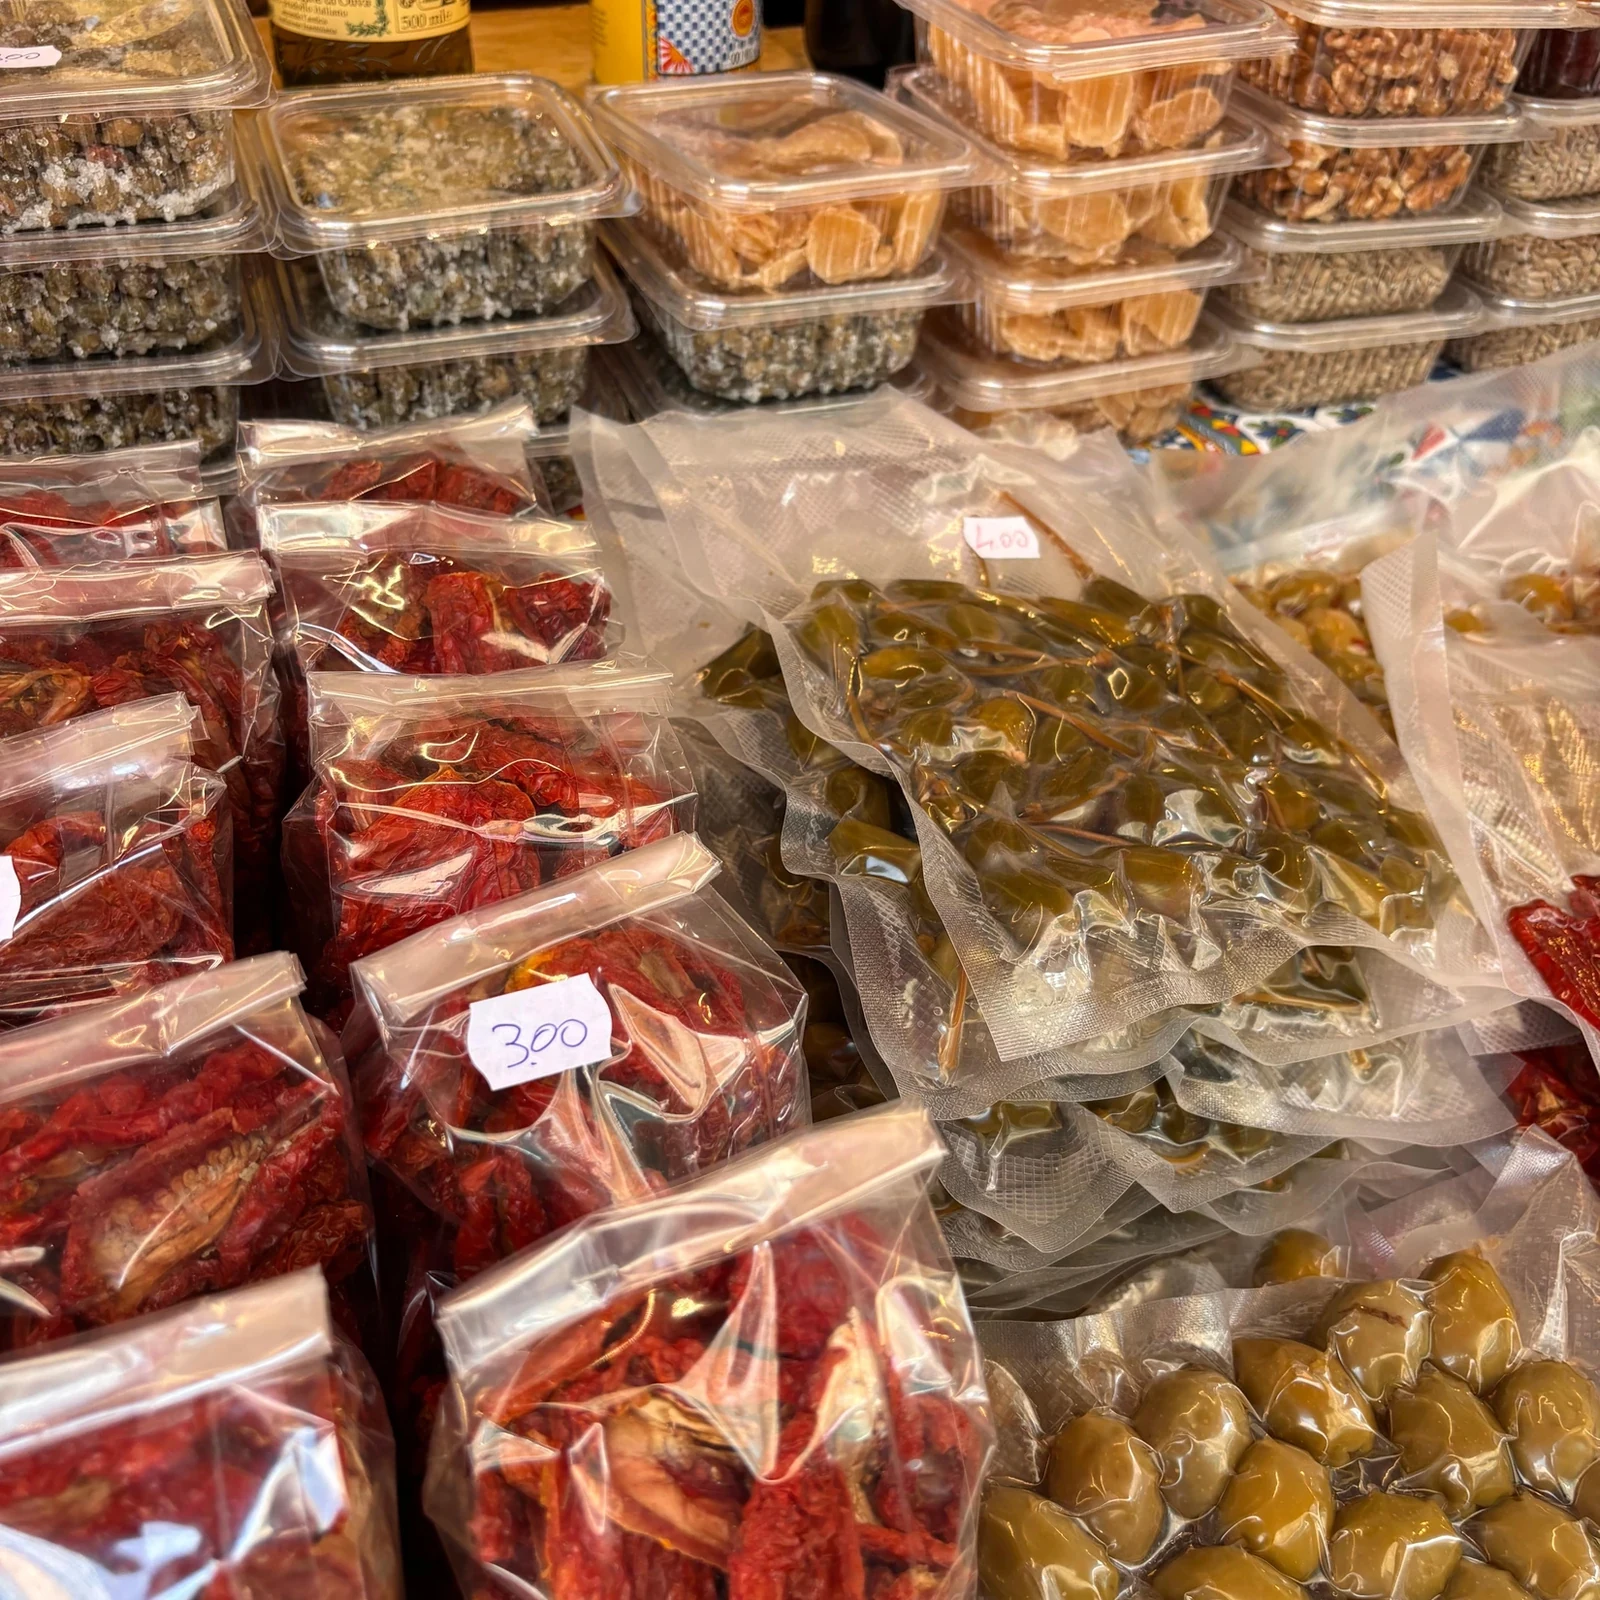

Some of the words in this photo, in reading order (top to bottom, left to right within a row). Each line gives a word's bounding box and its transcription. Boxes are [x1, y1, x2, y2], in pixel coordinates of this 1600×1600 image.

[400, 13, 427, 30] 500
[0, 52, 41, 63] .00
[492, 1018, 588, 1069] 3.00
